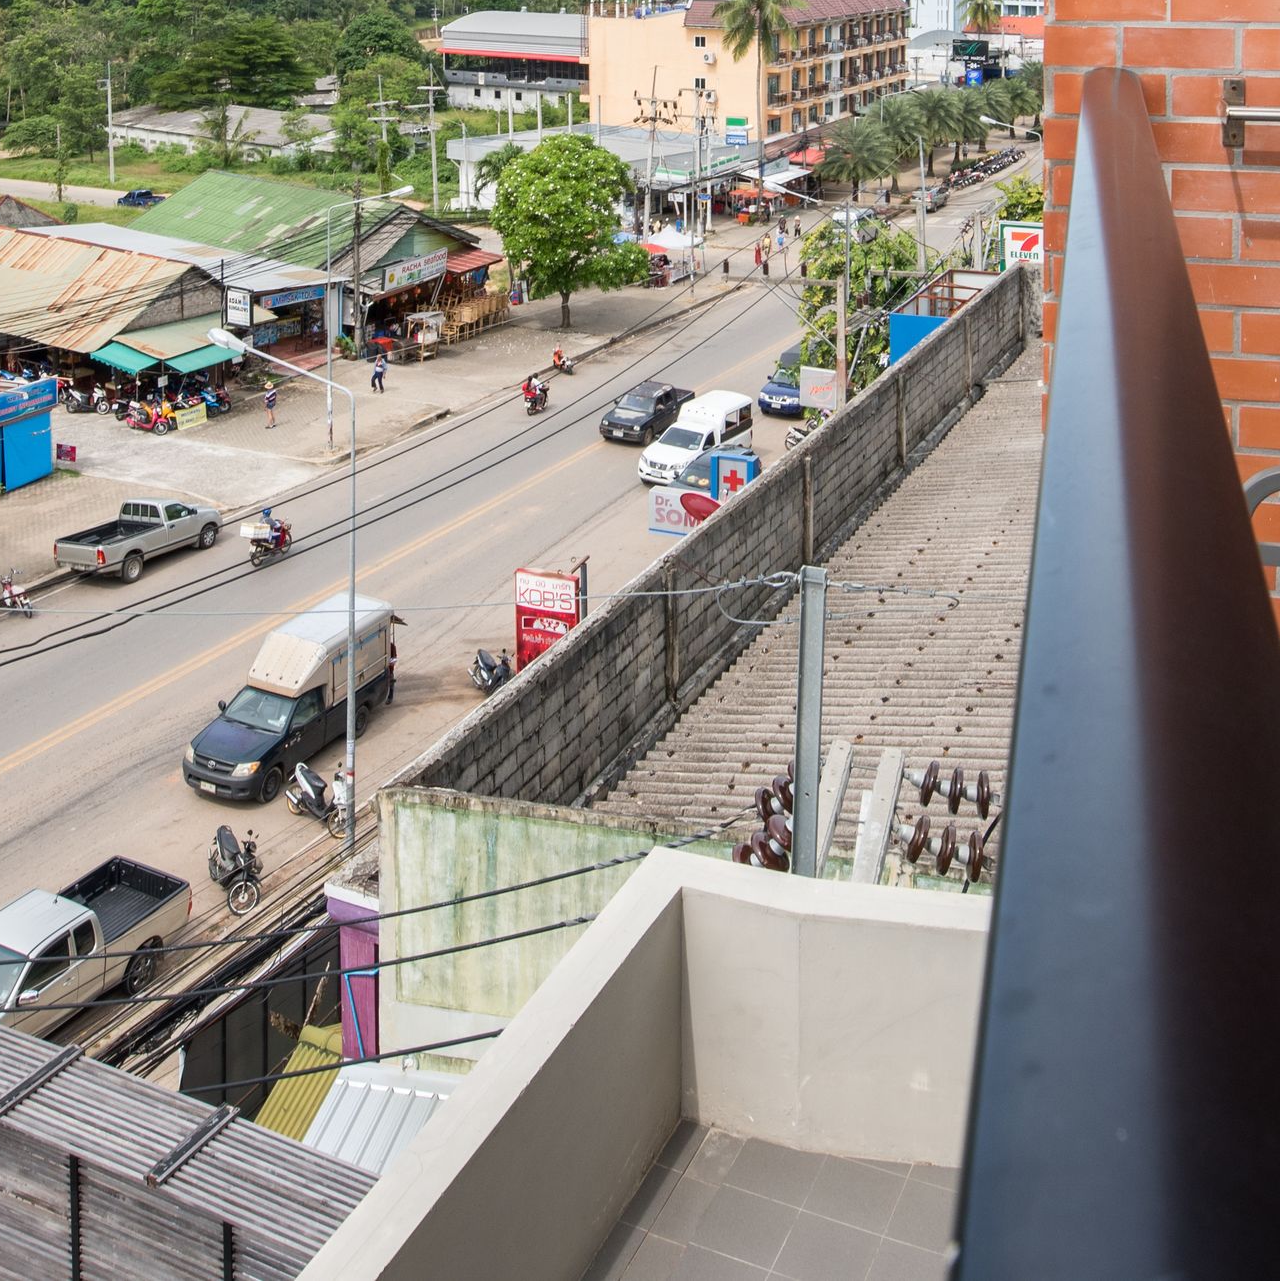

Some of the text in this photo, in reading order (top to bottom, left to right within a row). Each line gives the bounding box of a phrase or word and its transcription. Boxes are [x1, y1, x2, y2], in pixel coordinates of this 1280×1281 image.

[1011, 231, 1039, 252] 7
[401, 261, 422, 274] RACHA
[228, 297, 242, 305] ADAM
[655, 495, 673, 507] Dr.
[519, 586, 573, 611] KOB'S
